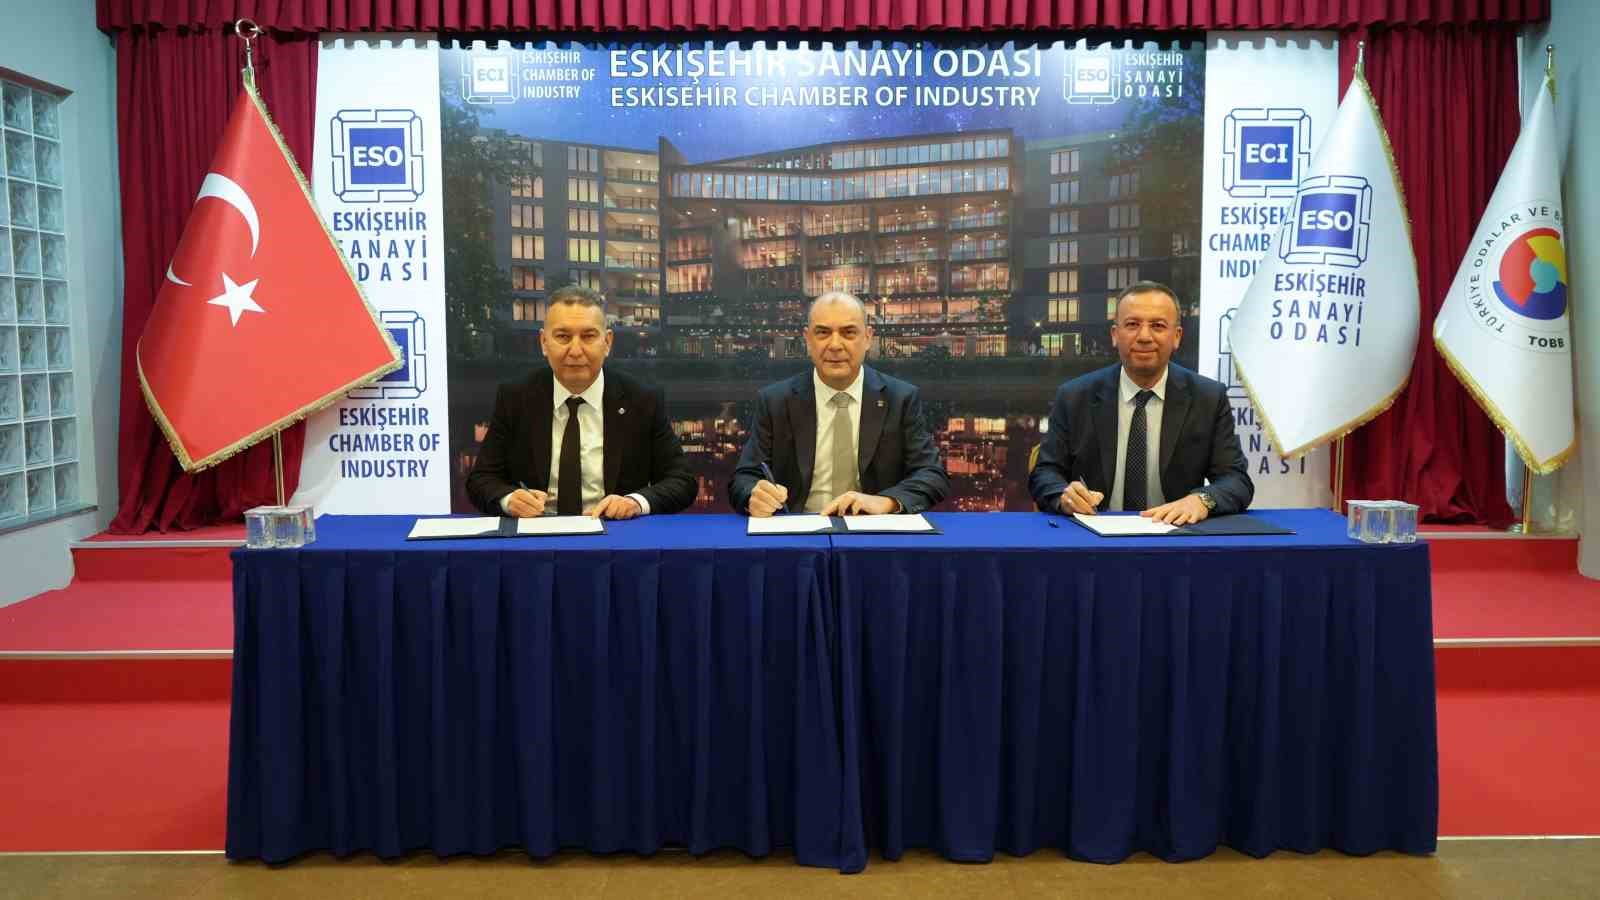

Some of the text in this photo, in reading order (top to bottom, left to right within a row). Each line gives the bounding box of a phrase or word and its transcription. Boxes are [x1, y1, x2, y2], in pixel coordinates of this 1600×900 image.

[798, 42, 922, 77] SANAYİ
[933, 49, 1040, 77] ODASI
[477, 68, 504, 81] ECI
[522, 68, 595, 81] CHAMBER OF
[1077, 69, 1108, 82] ESO
[1124, 68, 1183, 83] SANAYİ
[523, 85, 581, 98] INDUSTRY
[744, 86, 868, 107] CHAMBER
[875, 86, 908, 106] OF
[916, 86, 1041, 106] INDUSTRY
[1124, 85, 1183, 97] ODASI
[352, 146, 404, 167] ESO
[1245, 143, 1289, 163] ECI
[333, 208, 427, 236] ESKİŞEHİR
[1301, 210, 1353, 231] ESO
[1209, 233, 1272, 251] CHAMB
[1474, 213, 1521, 268] ODALAR
[1528, 206, 1549, 217] VE
[357, 262, 427, 281] DASI
[1274, 269, 1367, 298] ESKİŞEHİR
[1272, 299, 1364, 324] SANAYİ
[1270, 321, 1361, 346] ODASI
[339, 403, 430, 430] ESKİŞEHİR
[329, 433, 441, 452] CHAMBER OF
[341, 459, 430, 478] INDUSTRY
